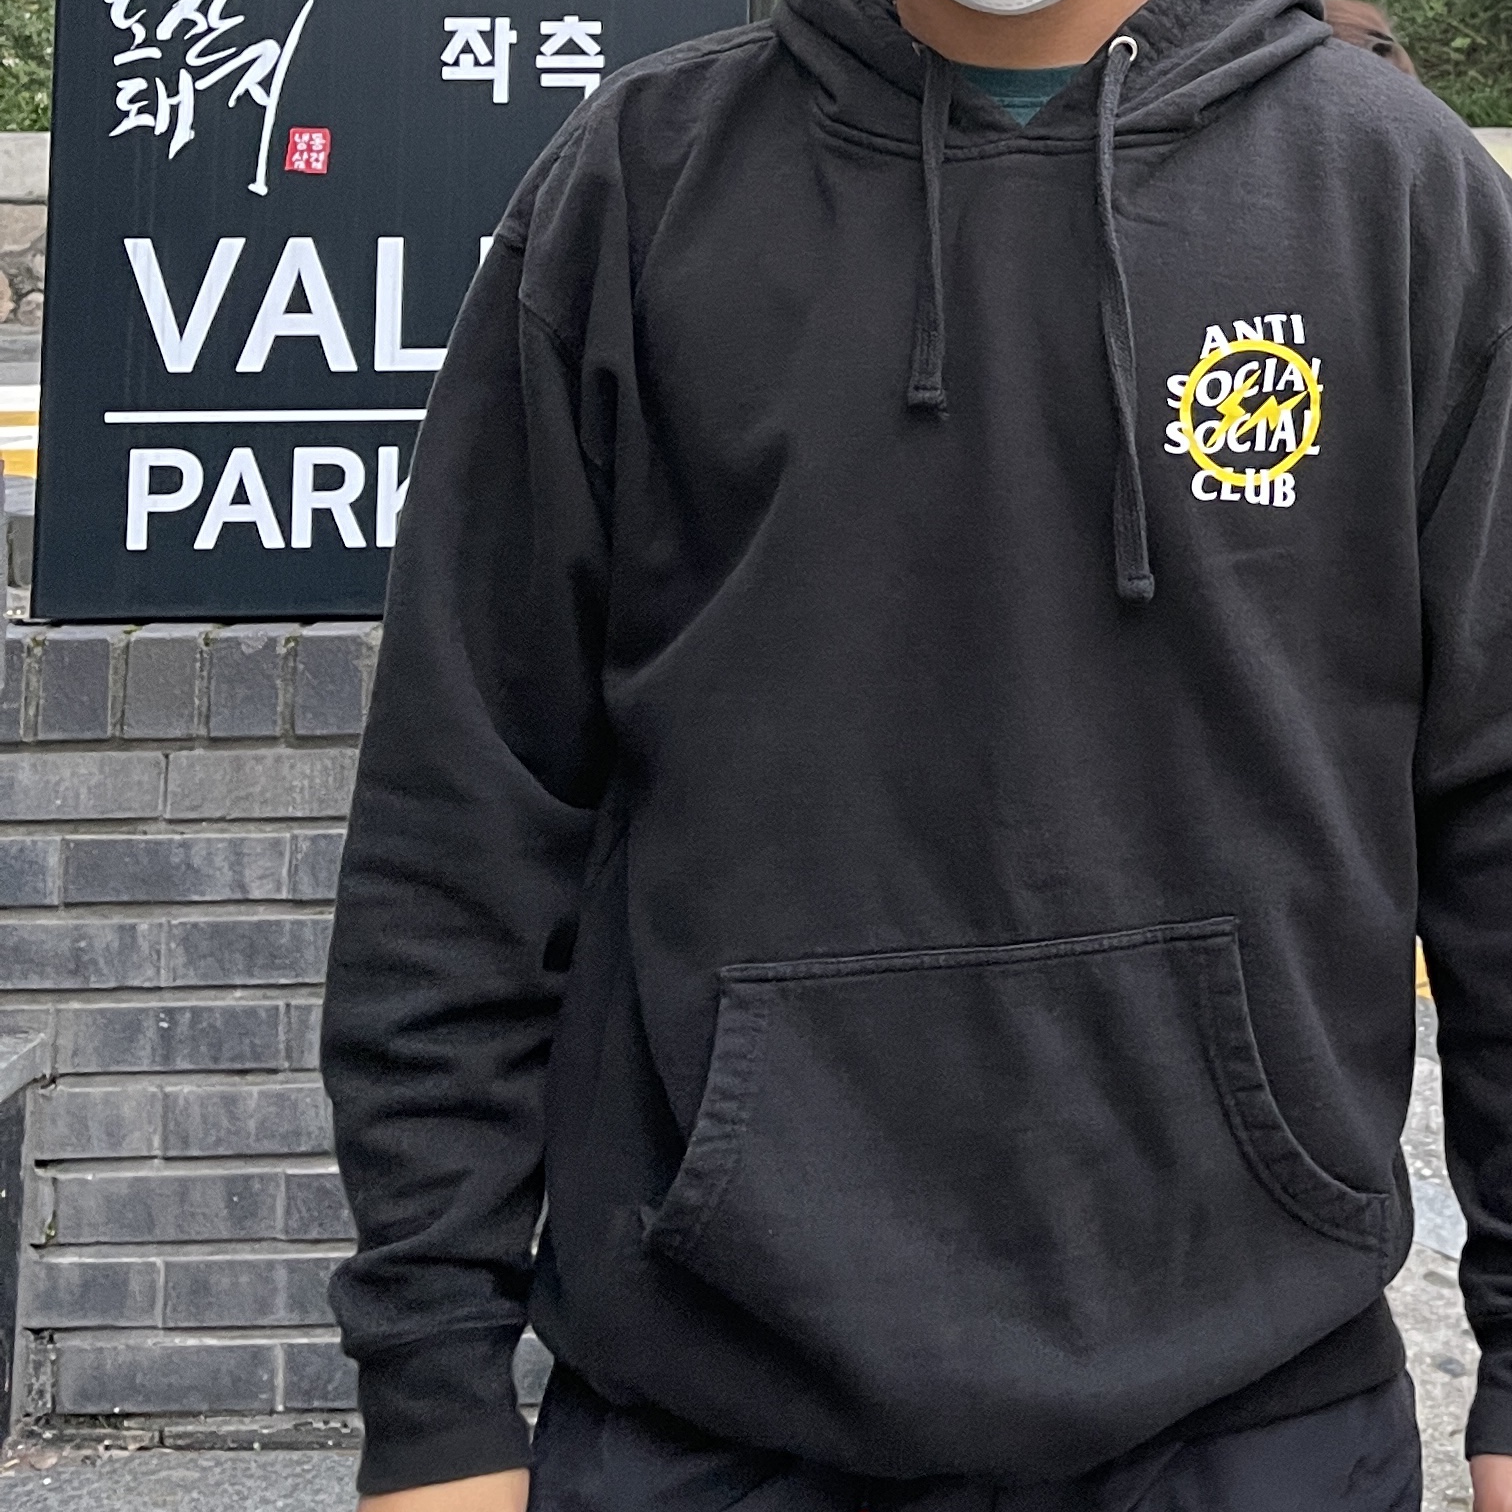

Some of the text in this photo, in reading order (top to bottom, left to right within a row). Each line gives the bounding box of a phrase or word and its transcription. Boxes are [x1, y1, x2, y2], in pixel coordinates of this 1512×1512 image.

[124, 236, 494, 373] VAL
[1200, 314, 1306, 359] ANTI
[1166, 357, 1324, 409] SOCIAL
[1163, 409, 1321, 456] SOCIAL
[1191, 467, 1296, 508] CLUB
